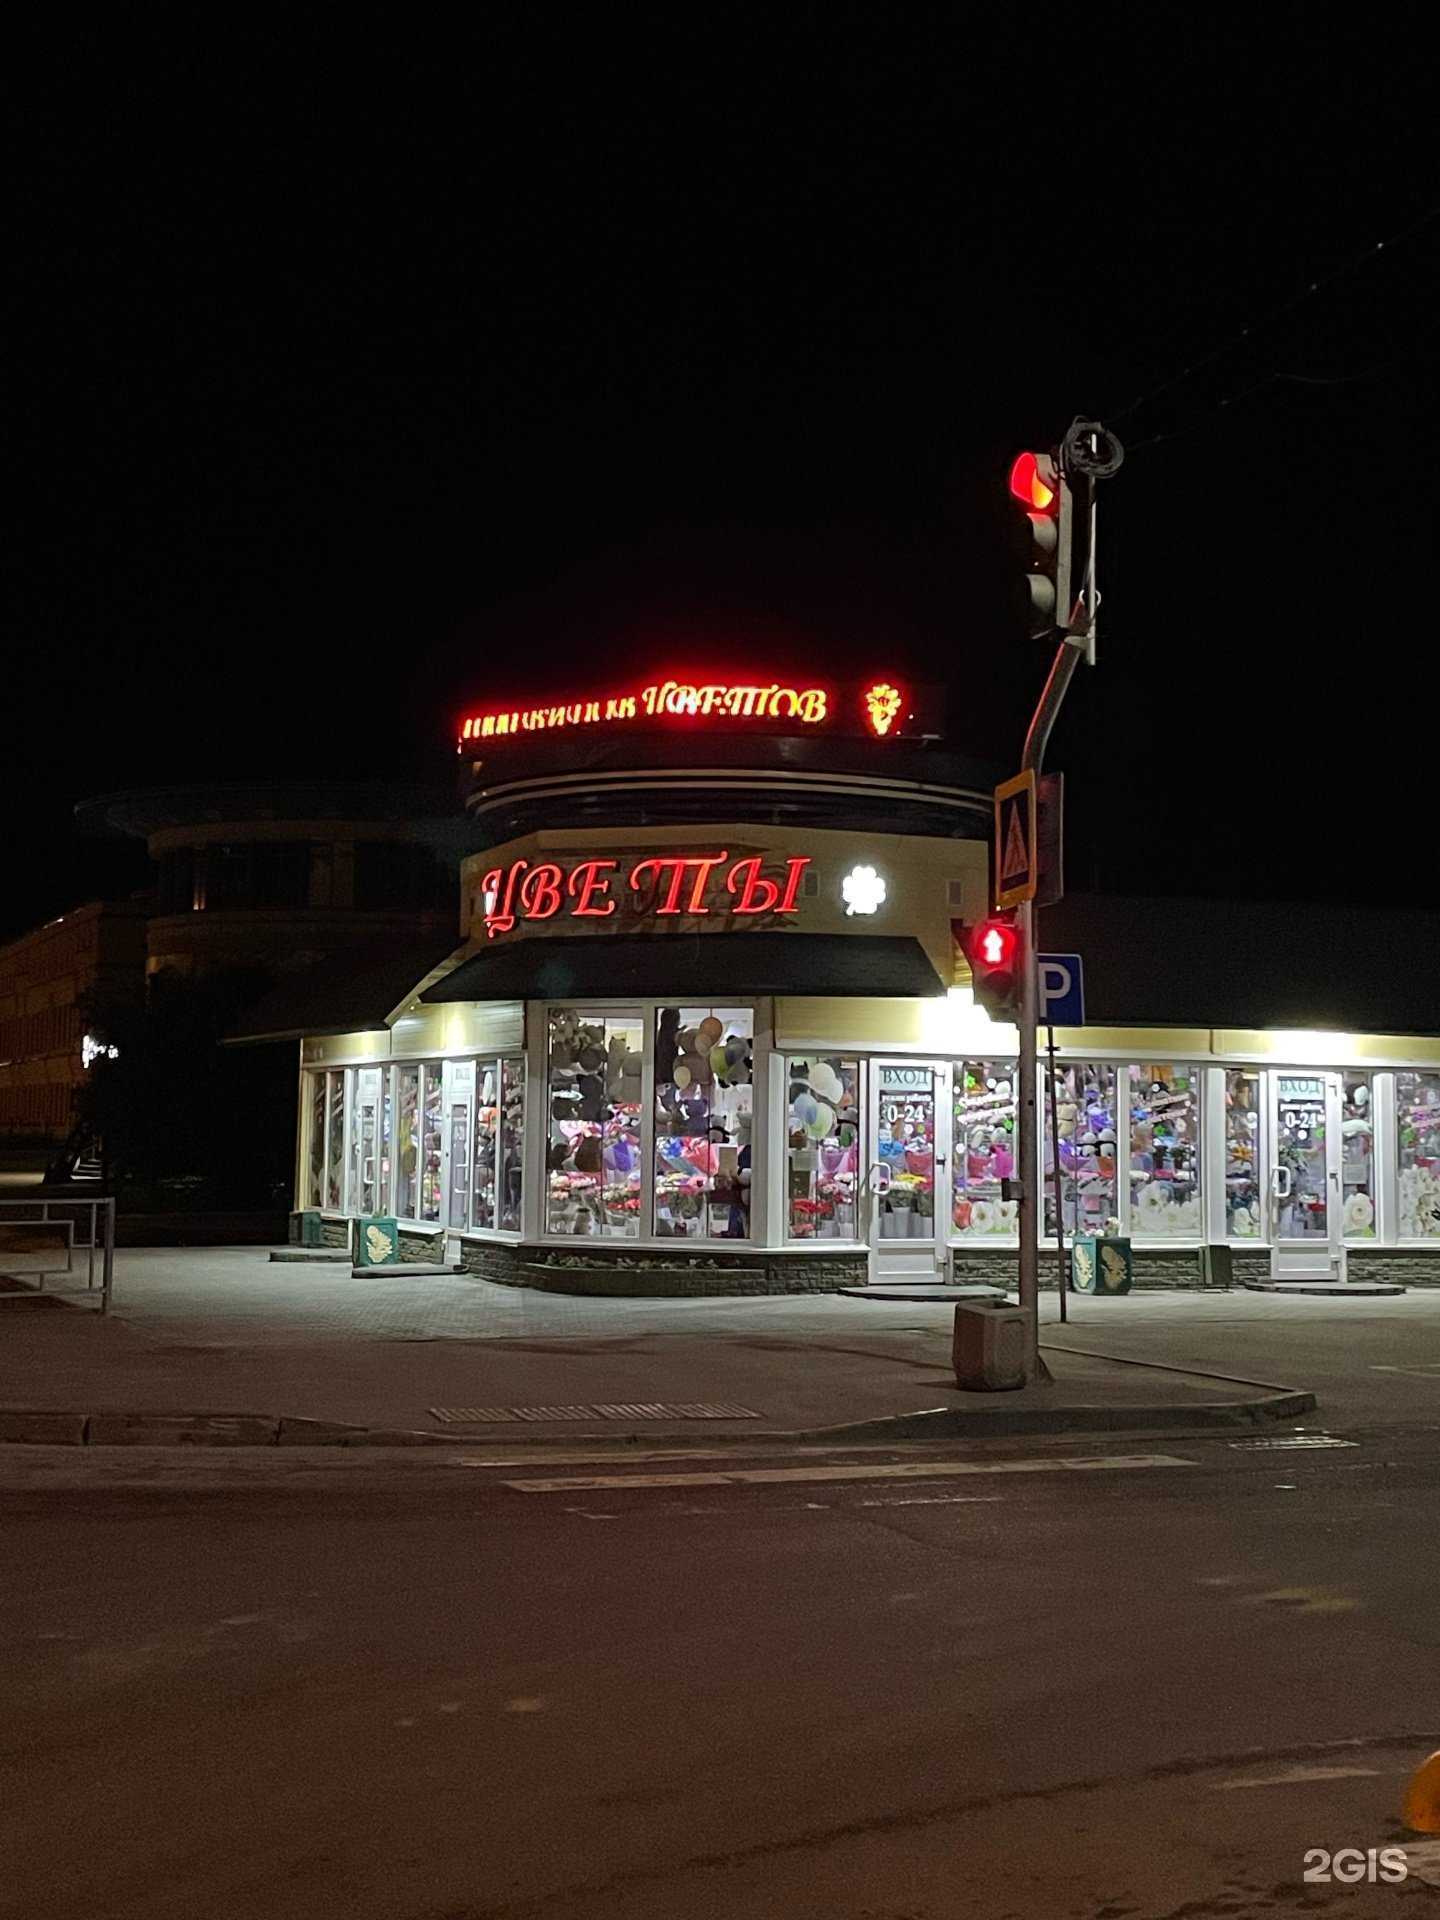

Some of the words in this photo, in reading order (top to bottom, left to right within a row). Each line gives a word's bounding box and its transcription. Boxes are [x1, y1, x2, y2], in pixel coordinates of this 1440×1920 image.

[481, 851, 812, 938] ЦВЕТЫ
[1038, 962, 1071, 1018] P
[882, 1068, 929, 1087] ВХОД
[1280, 1079, 1322, 1095] ВХОД
[887, 1104, 926, 1124] 0-24
[1285, 1111, 1318, 1129] 0-24
